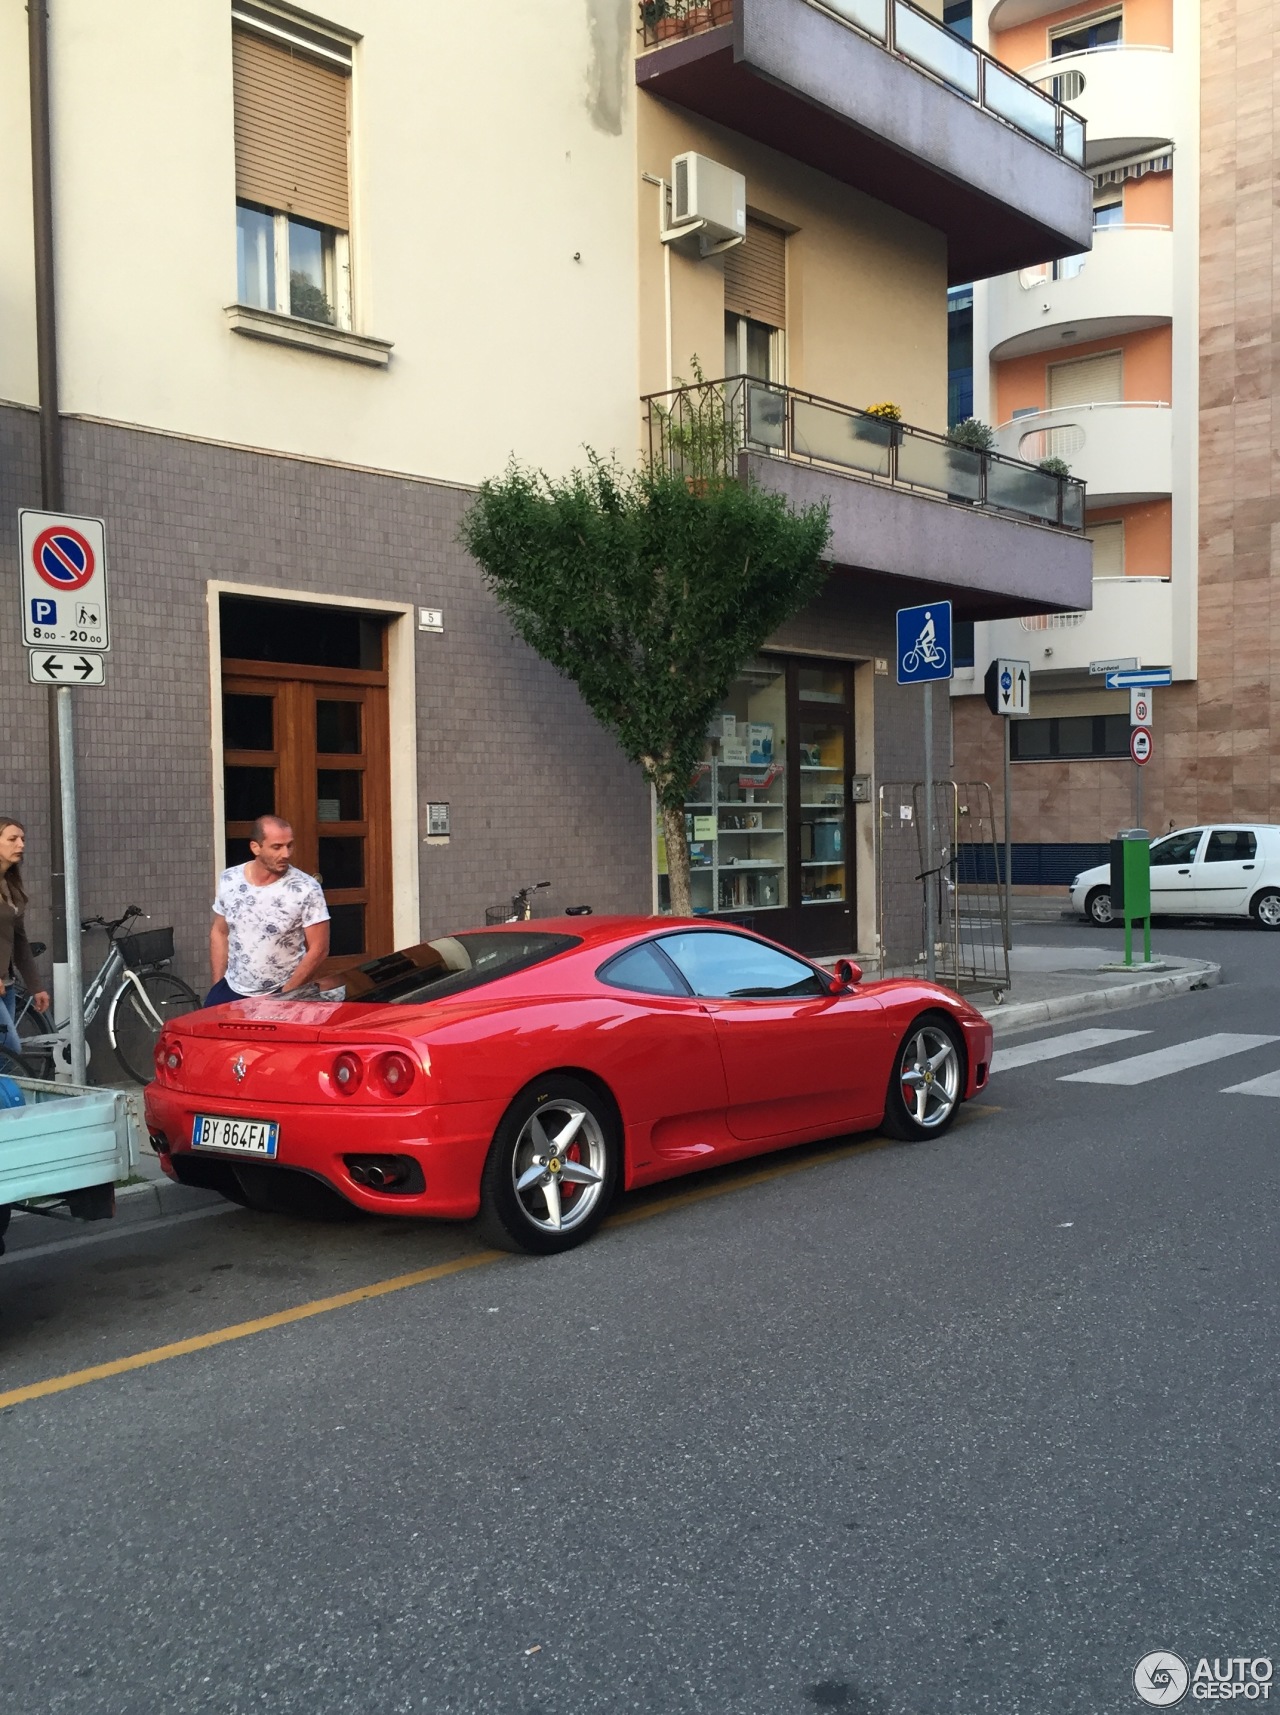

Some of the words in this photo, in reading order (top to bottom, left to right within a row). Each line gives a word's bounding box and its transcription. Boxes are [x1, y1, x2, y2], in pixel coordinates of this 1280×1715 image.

[36, 601, 51, 622] P
[428, 612, 434, 623] 5
[1138, 706, 1145, 716] 30
[202, 1120, 219, 1144] BY
[222, 1122, 265, 1150] 864FA
